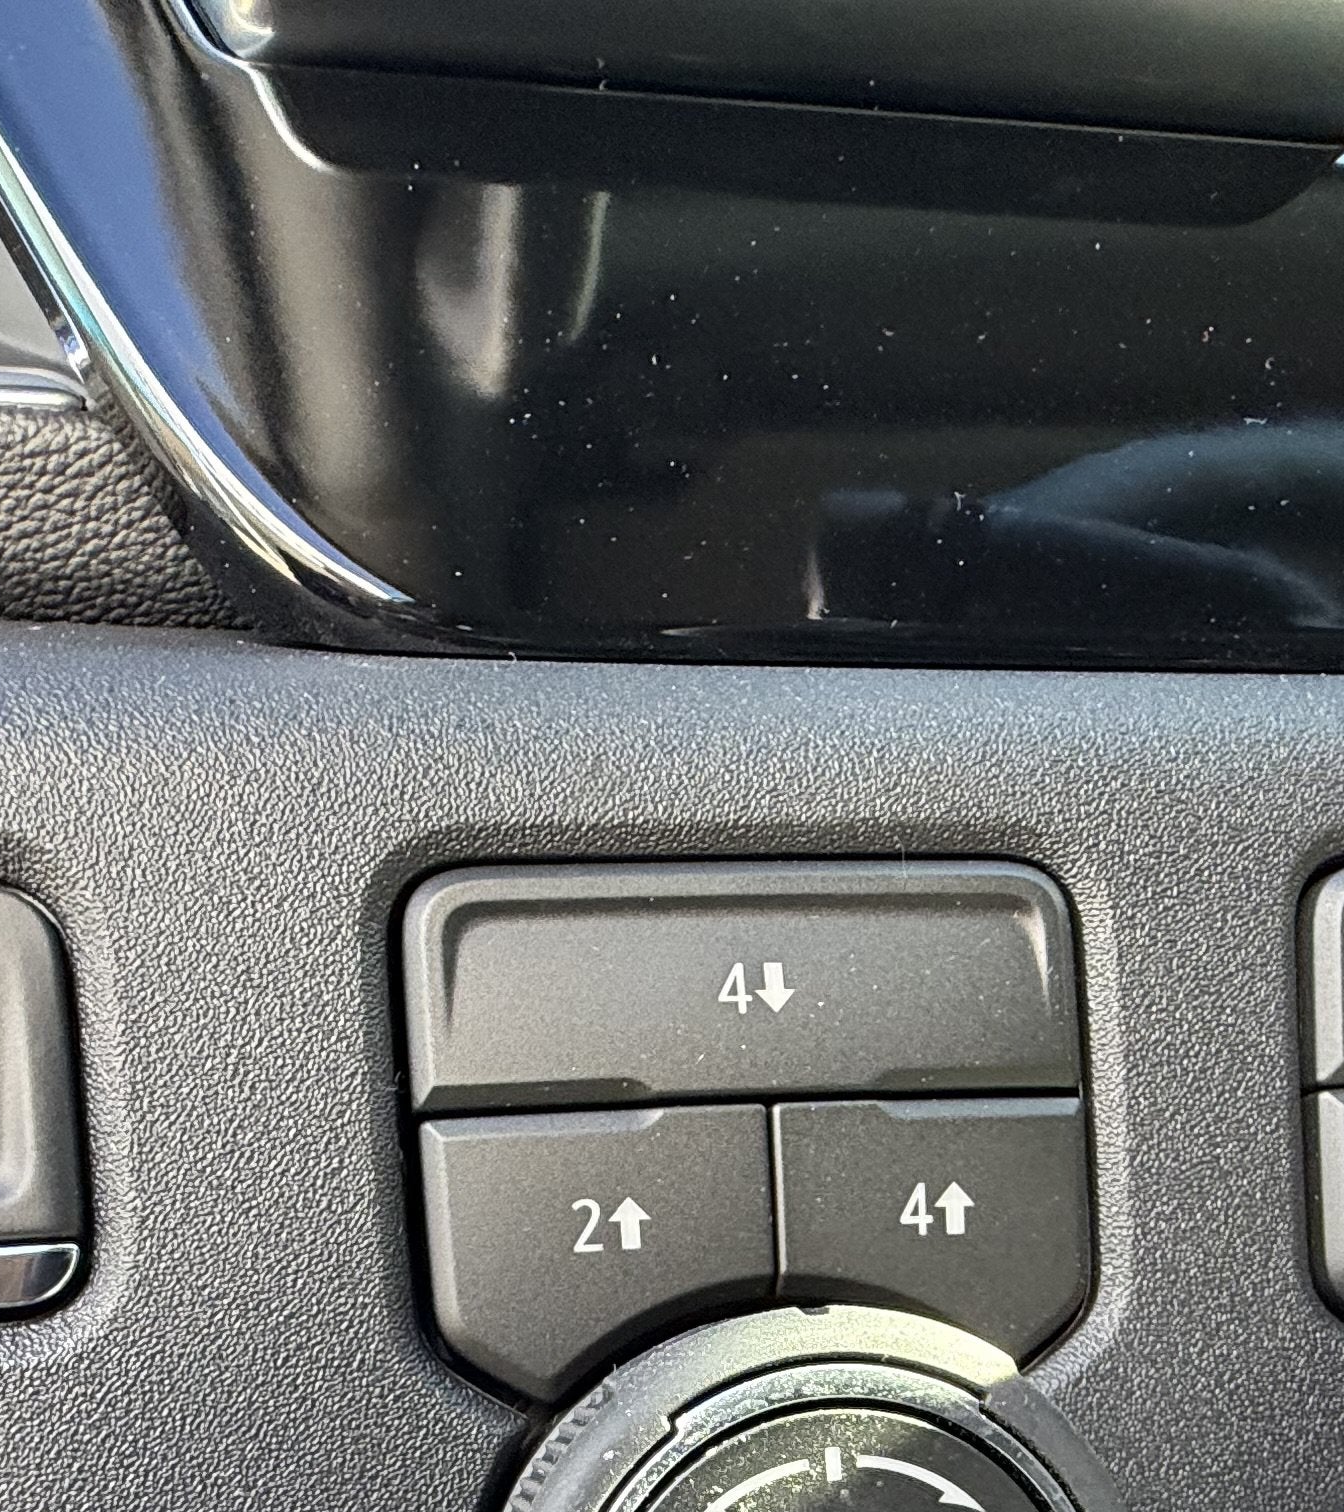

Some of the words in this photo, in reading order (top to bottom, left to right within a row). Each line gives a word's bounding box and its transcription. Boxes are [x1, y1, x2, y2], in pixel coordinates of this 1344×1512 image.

[718, 962, 753, 1014] 4
[572, 1199, 604, 1253] 2
[900, 1182, 934, 1235] 4
